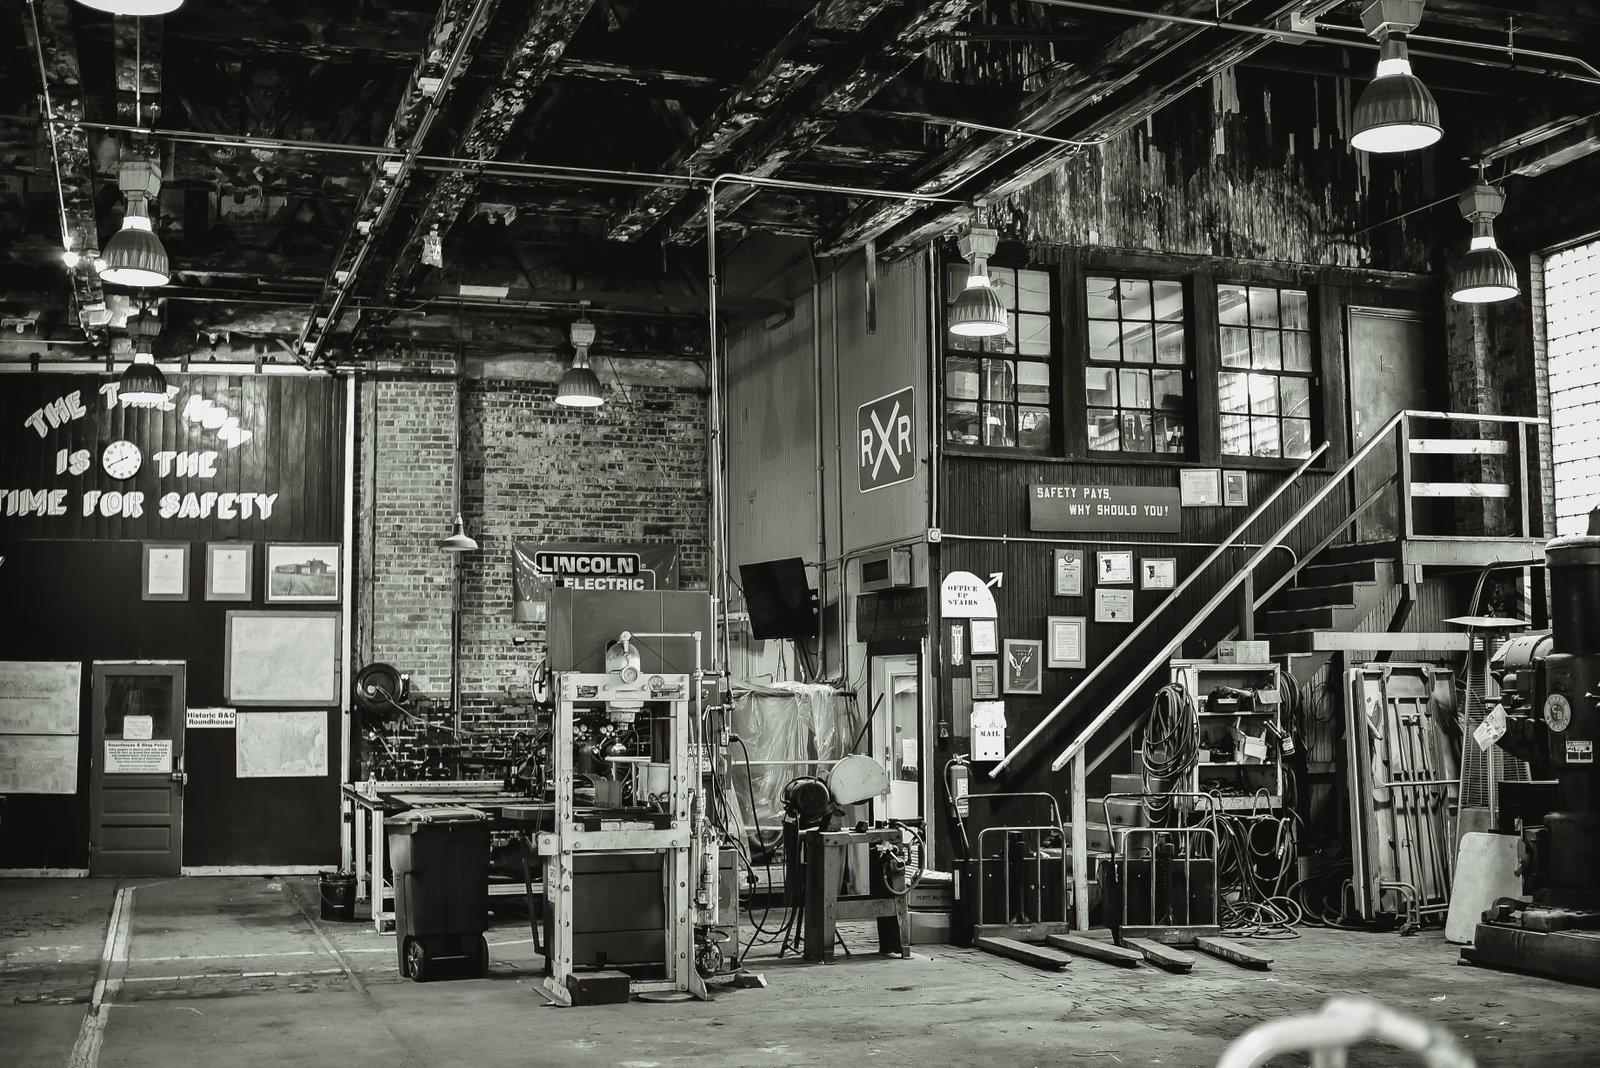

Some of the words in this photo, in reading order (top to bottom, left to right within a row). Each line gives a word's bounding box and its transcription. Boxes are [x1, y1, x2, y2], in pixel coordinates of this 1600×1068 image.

[24, 390, 87, 438] THE
[56, 448, 91, 476] IS
[153, 451, 219, 478] THE
[1036, 487, 1077, 499] SAFETY
[1083, 488, 1112, 501] PAYS,
[83, 490, 145, 517] FOR
[159, 491, 279, 520] SAFETY
[1069, 504, 1091, 516] WHY
[1097, 505, 1138, 517] SHOULD
[1144, 505, 1169, 517] YOU!
[541, 556, 634, 574] LINCOLN
[563, 577, 645, 591] ELECTRIC
[187, 711, 216, 719] Historic
[218, 711, 235, 719] B&O
